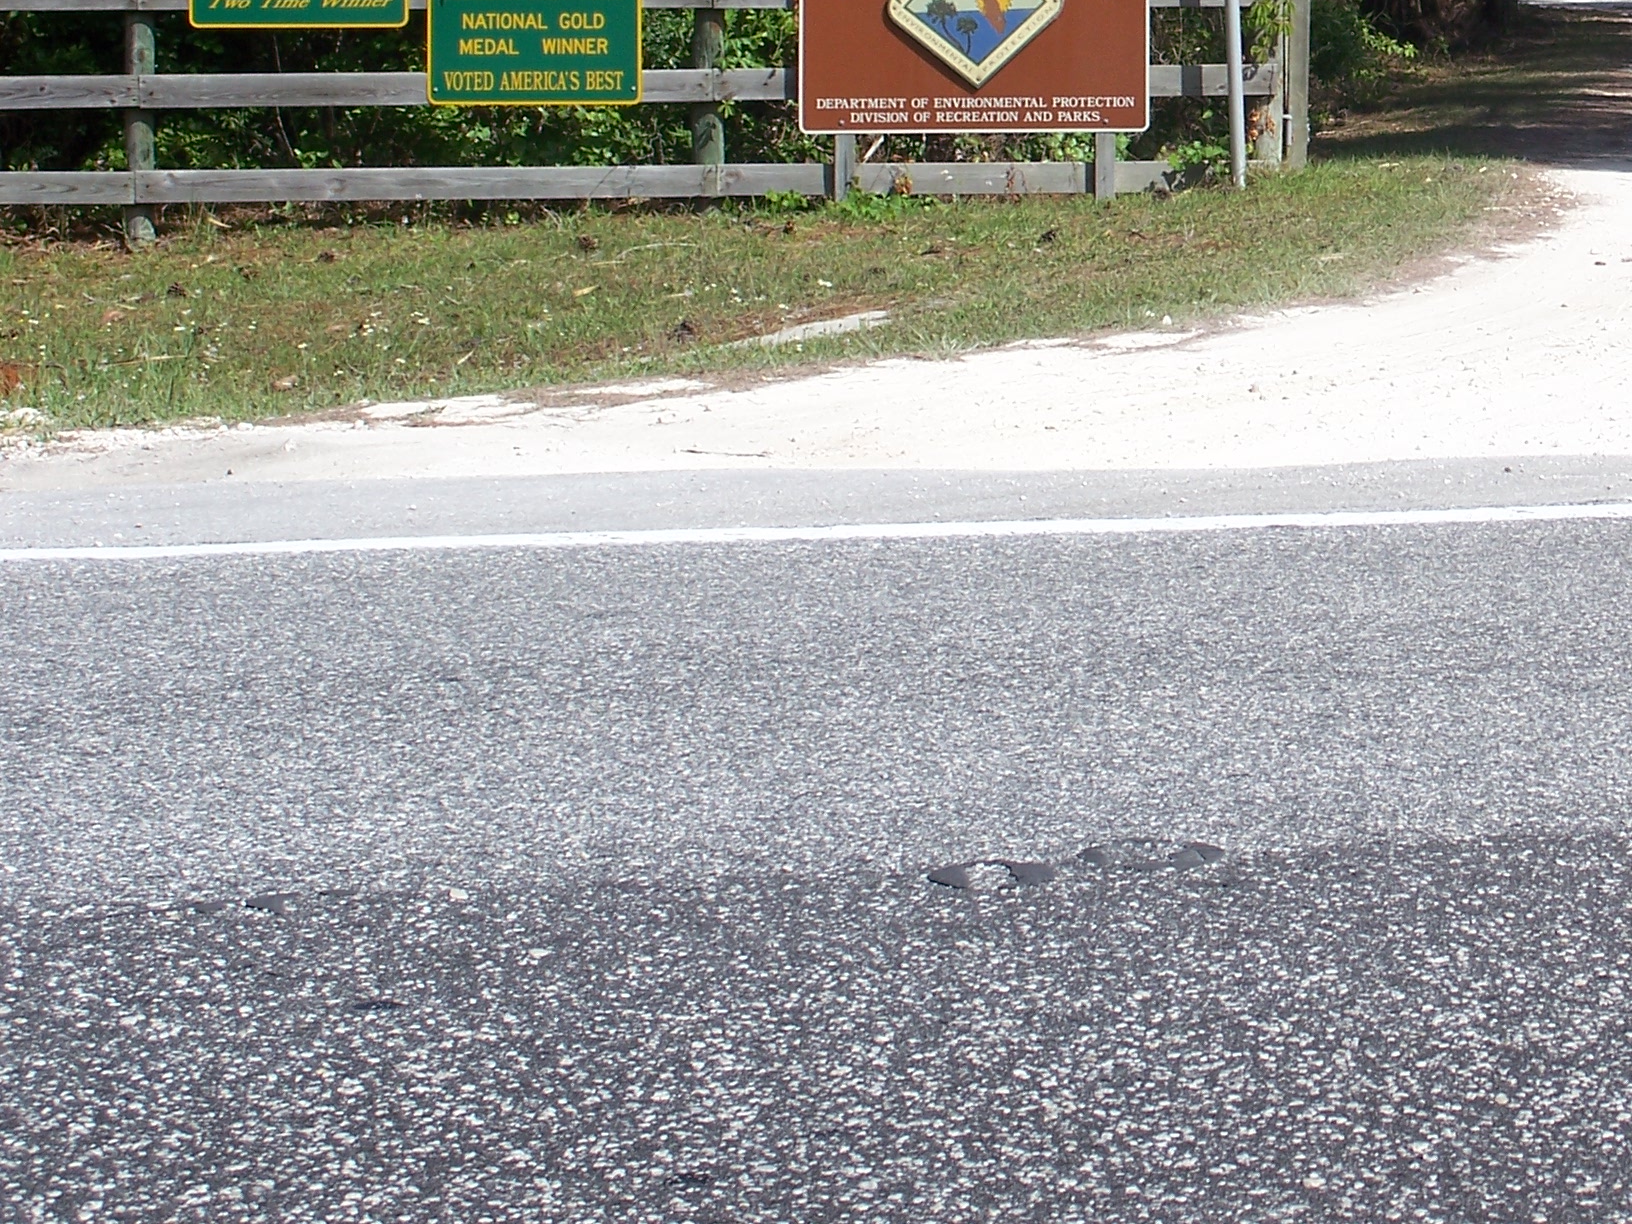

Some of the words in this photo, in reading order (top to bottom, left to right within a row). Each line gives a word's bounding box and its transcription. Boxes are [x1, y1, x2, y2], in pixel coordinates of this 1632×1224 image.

[462, 12, 548, 30] NATIONAL
[558, 12, 606, 30] GOLD
[458, 38, 519, 55] MEDAL
[542, 37, 608, 55] WINNER
[897, 10, 974, 73] ENVIRONMENTAL
[981, 5, 1055, 73] PROTECTION
[443, 71, 495, 92] VOTED
[499, 71, 581, 92] AMERICA'S
[585, 70, 625, 91] BEST
[816, 97, 907, 111] DEPARTMENT
[910, 97, 929, 110] OF
[933, 96, 1047, 110] ENVIRONMENTAL
[1052, 96, 1136, 109] PROTECTION
[850, 111, 909, 124] DIVISION
[913, 111, 931, 123] OF
[935, 111, 1019, 123] RECREATION
[1023, 111, 1053, 123] AND
[1057, 111, 1101, 123] PARKS
